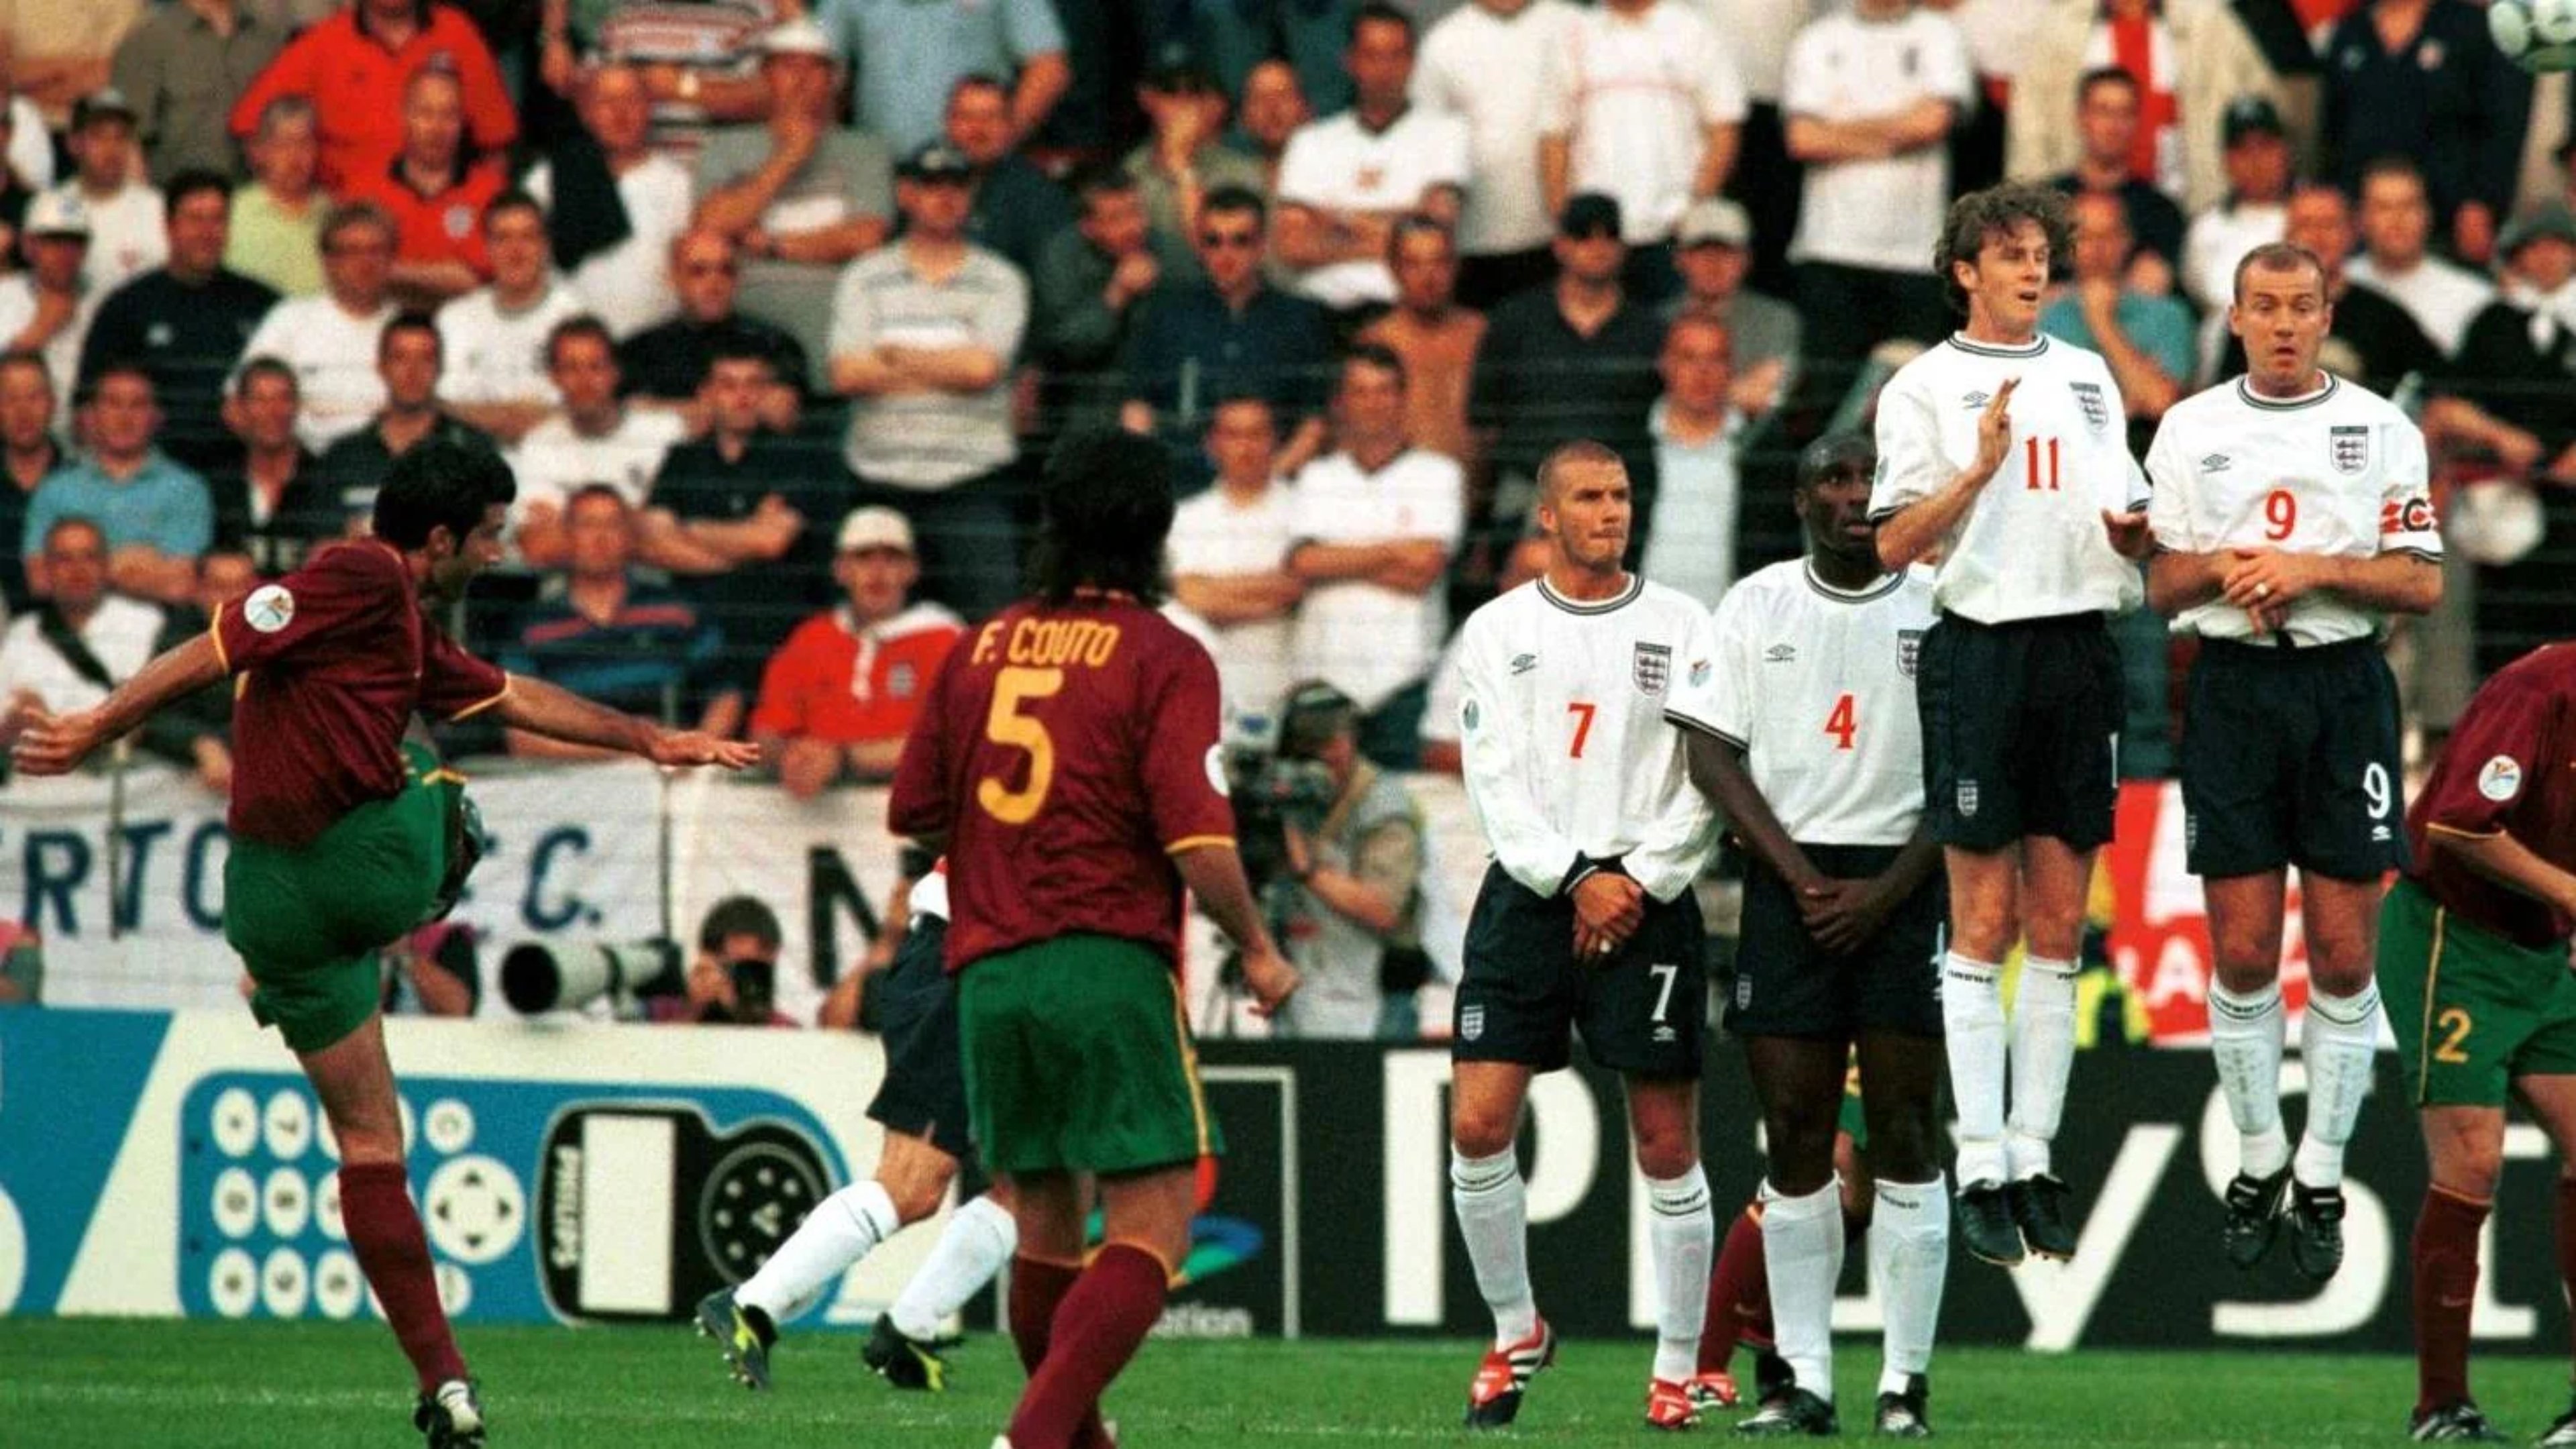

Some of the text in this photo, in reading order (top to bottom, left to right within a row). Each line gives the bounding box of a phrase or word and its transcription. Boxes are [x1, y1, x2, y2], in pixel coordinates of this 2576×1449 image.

[2025, 436, 2061, 492] 11
[2265, 490, 2297, 541] 9
[2402, 497, 2431, 533] C
[971, 617, 1121, 666] F. COUTO
[977, 666, 1064, 824] 5
[1567, 702, 1597, 758] 7
[1825, 694, 1858, 750] 4
[2363, 761, 2392, 819] 9
[0, 820, 229, 936] RTO
[1650, 963, 1678, 1021] 7
[2434, 1008, 2472, 1063] 2
[1383, 1050, 2551, 1352] PyS
